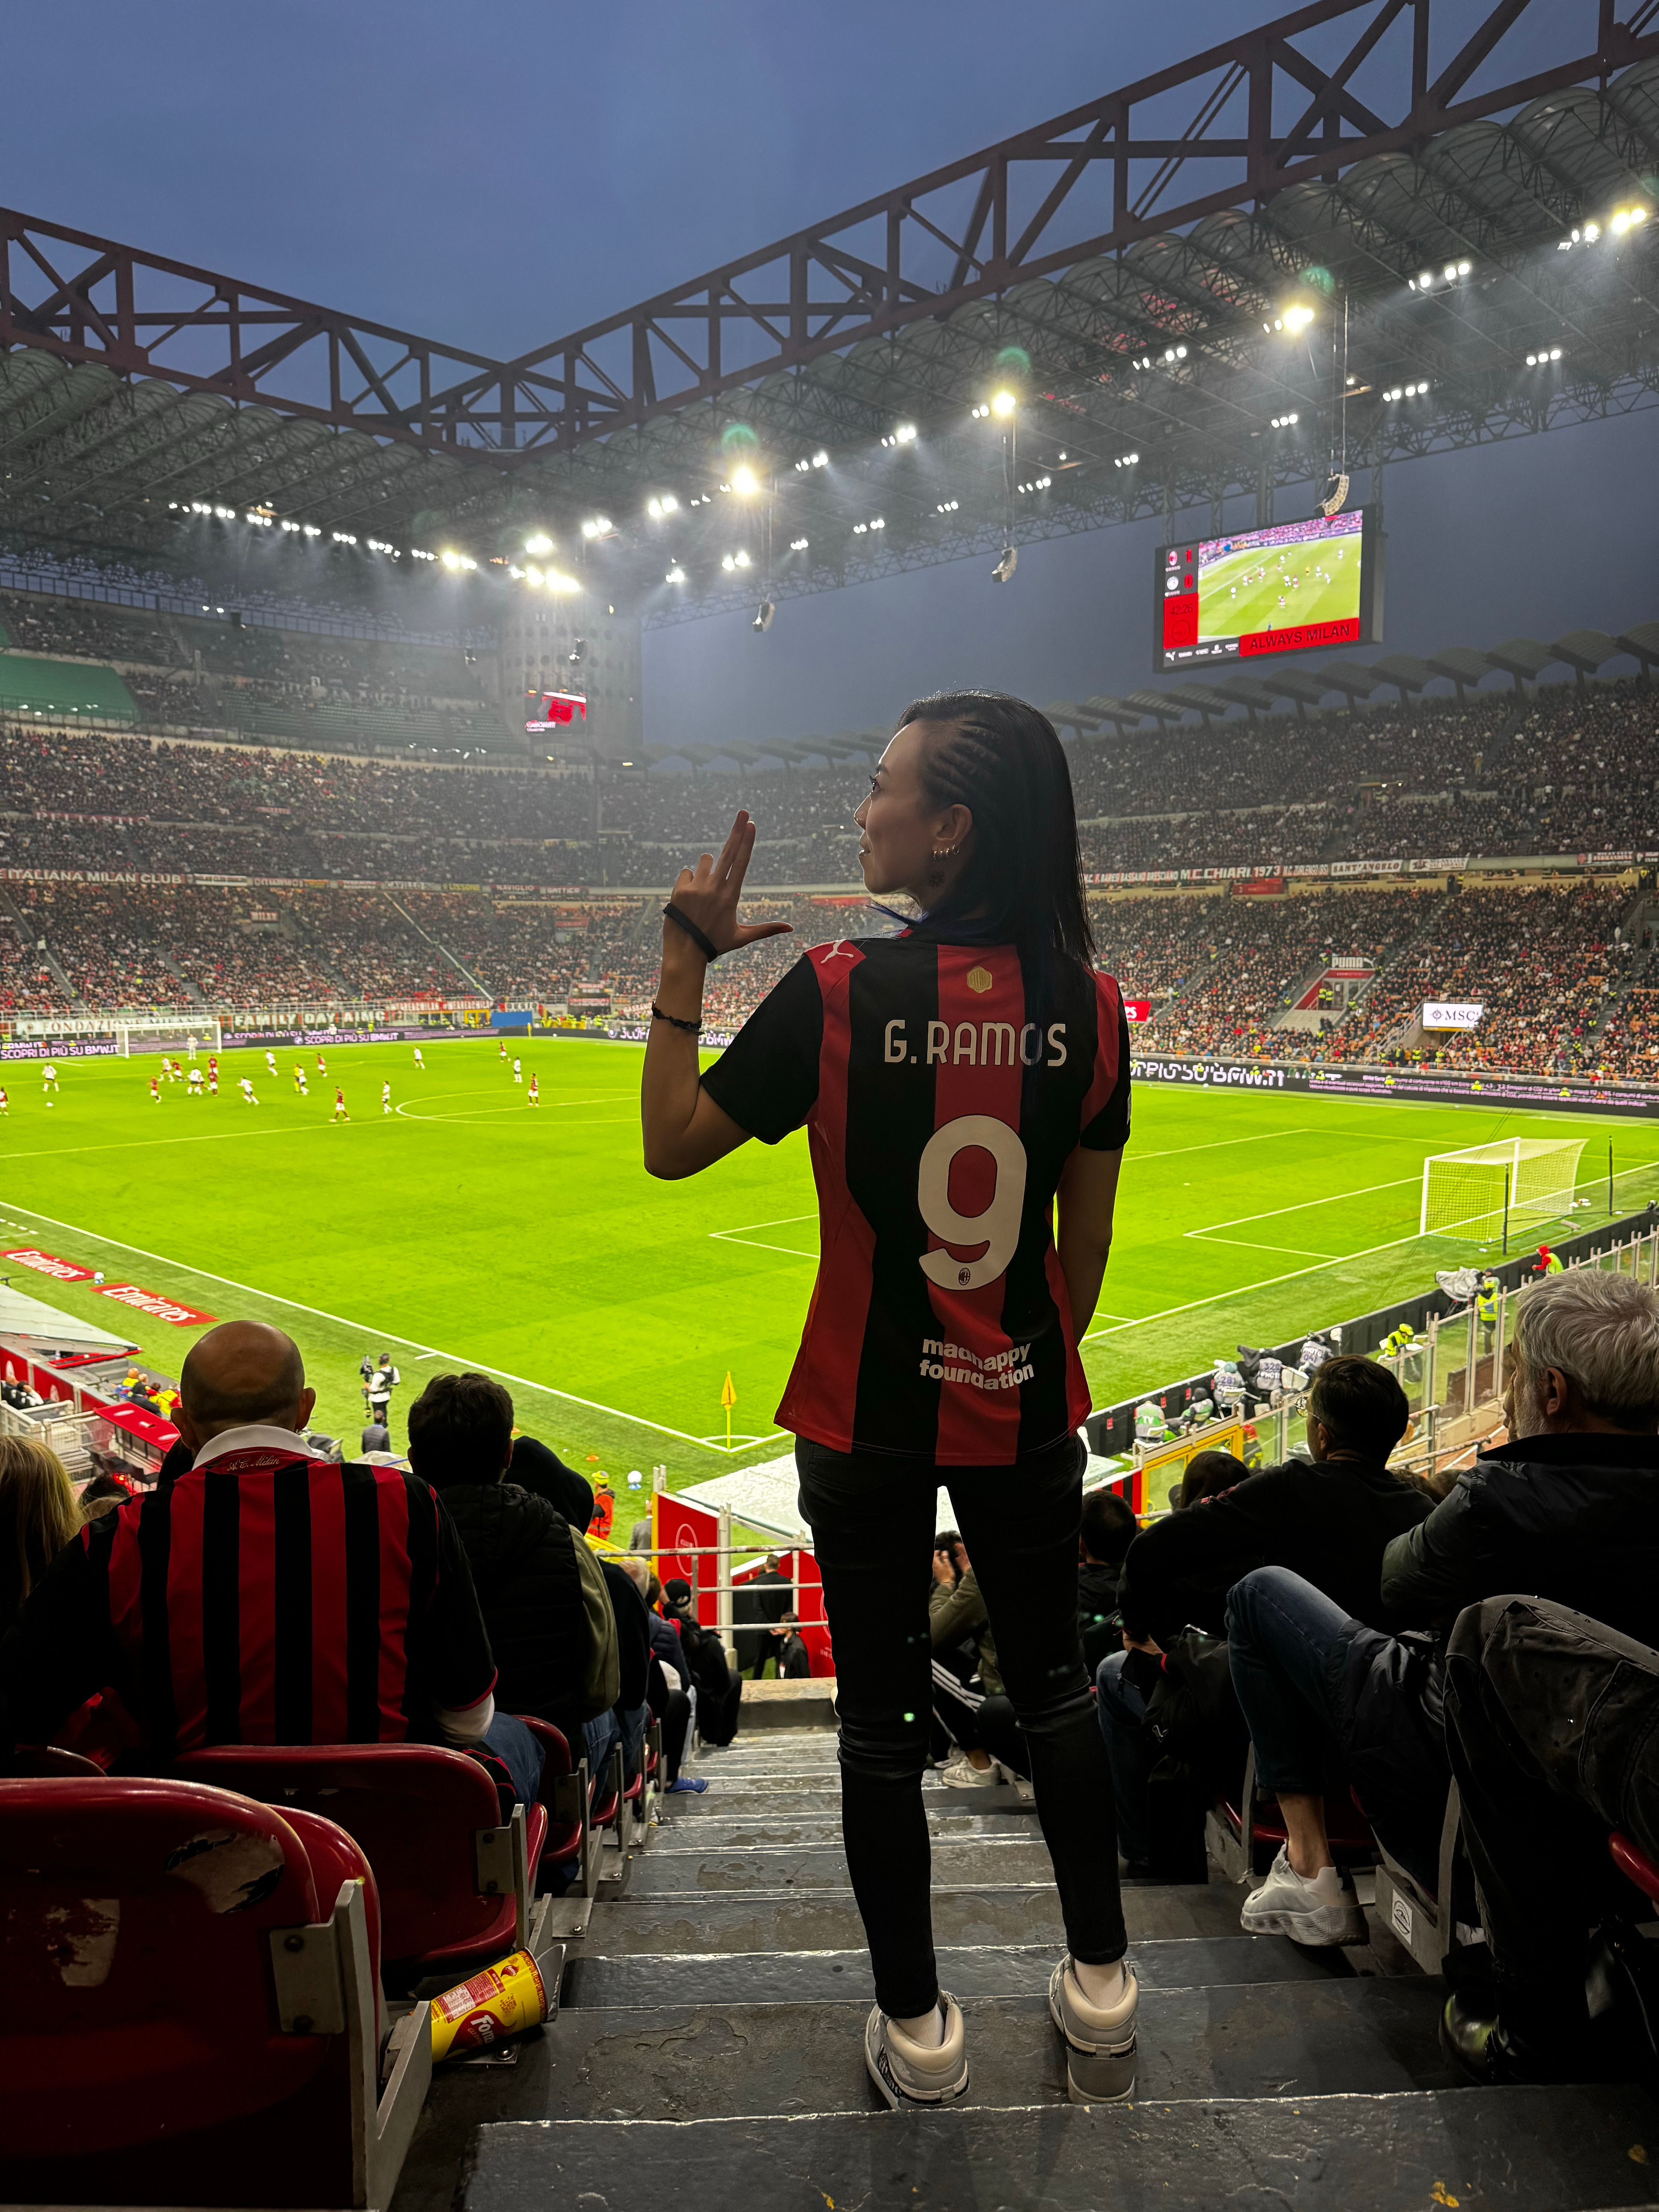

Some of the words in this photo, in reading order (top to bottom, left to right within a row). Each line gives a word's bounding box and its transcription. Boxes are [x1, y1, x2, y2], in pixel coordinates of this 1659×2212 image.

[1185, 549, 1192, 563] 1
[1184, 574, 1193, 588] 0
[1170, 603, 1193, 615] 42:26
[1250, 635, 1302, 650] ALWAYS
[1306, 624, 1350, 641] MILAN
[8, 869, 83, 881] ITALIANA
[87, 872, 137, 882] MILAN
[140, 874, 182, 884] CLUB
[1254, 865, 1280, 877] 1973
[1332, 957, 1363, 967] PUMA
[235, 1013, 296, 1026] FAMILY
[304, 1012, 335, 1024] DAY
[1444, 1010, 1475, 1022] MSC
[304, 1036, 333, 1044] SCOPRI
[1, 1048, 38, 1059] SCOPRI
[39, 1048, 50, 1057] DI
[51, 1045, 68, 1056] PIÙ
[69, 1046, 83, 1056] SU
[85, 1044, 119, 1054] BMW.IT
[918, 1115, 1027, 1290] 9
[7, 1251, 85, 1278] Emirates
[102, 1286, 197, 1321] Emirates
[1263, 1362, 1280, 1372] 320
[919, 1359, 1034, 1390] foundation
[1142, 1416, 1154, 1424] TV
[251, 1454, 280, 1466] Milan
